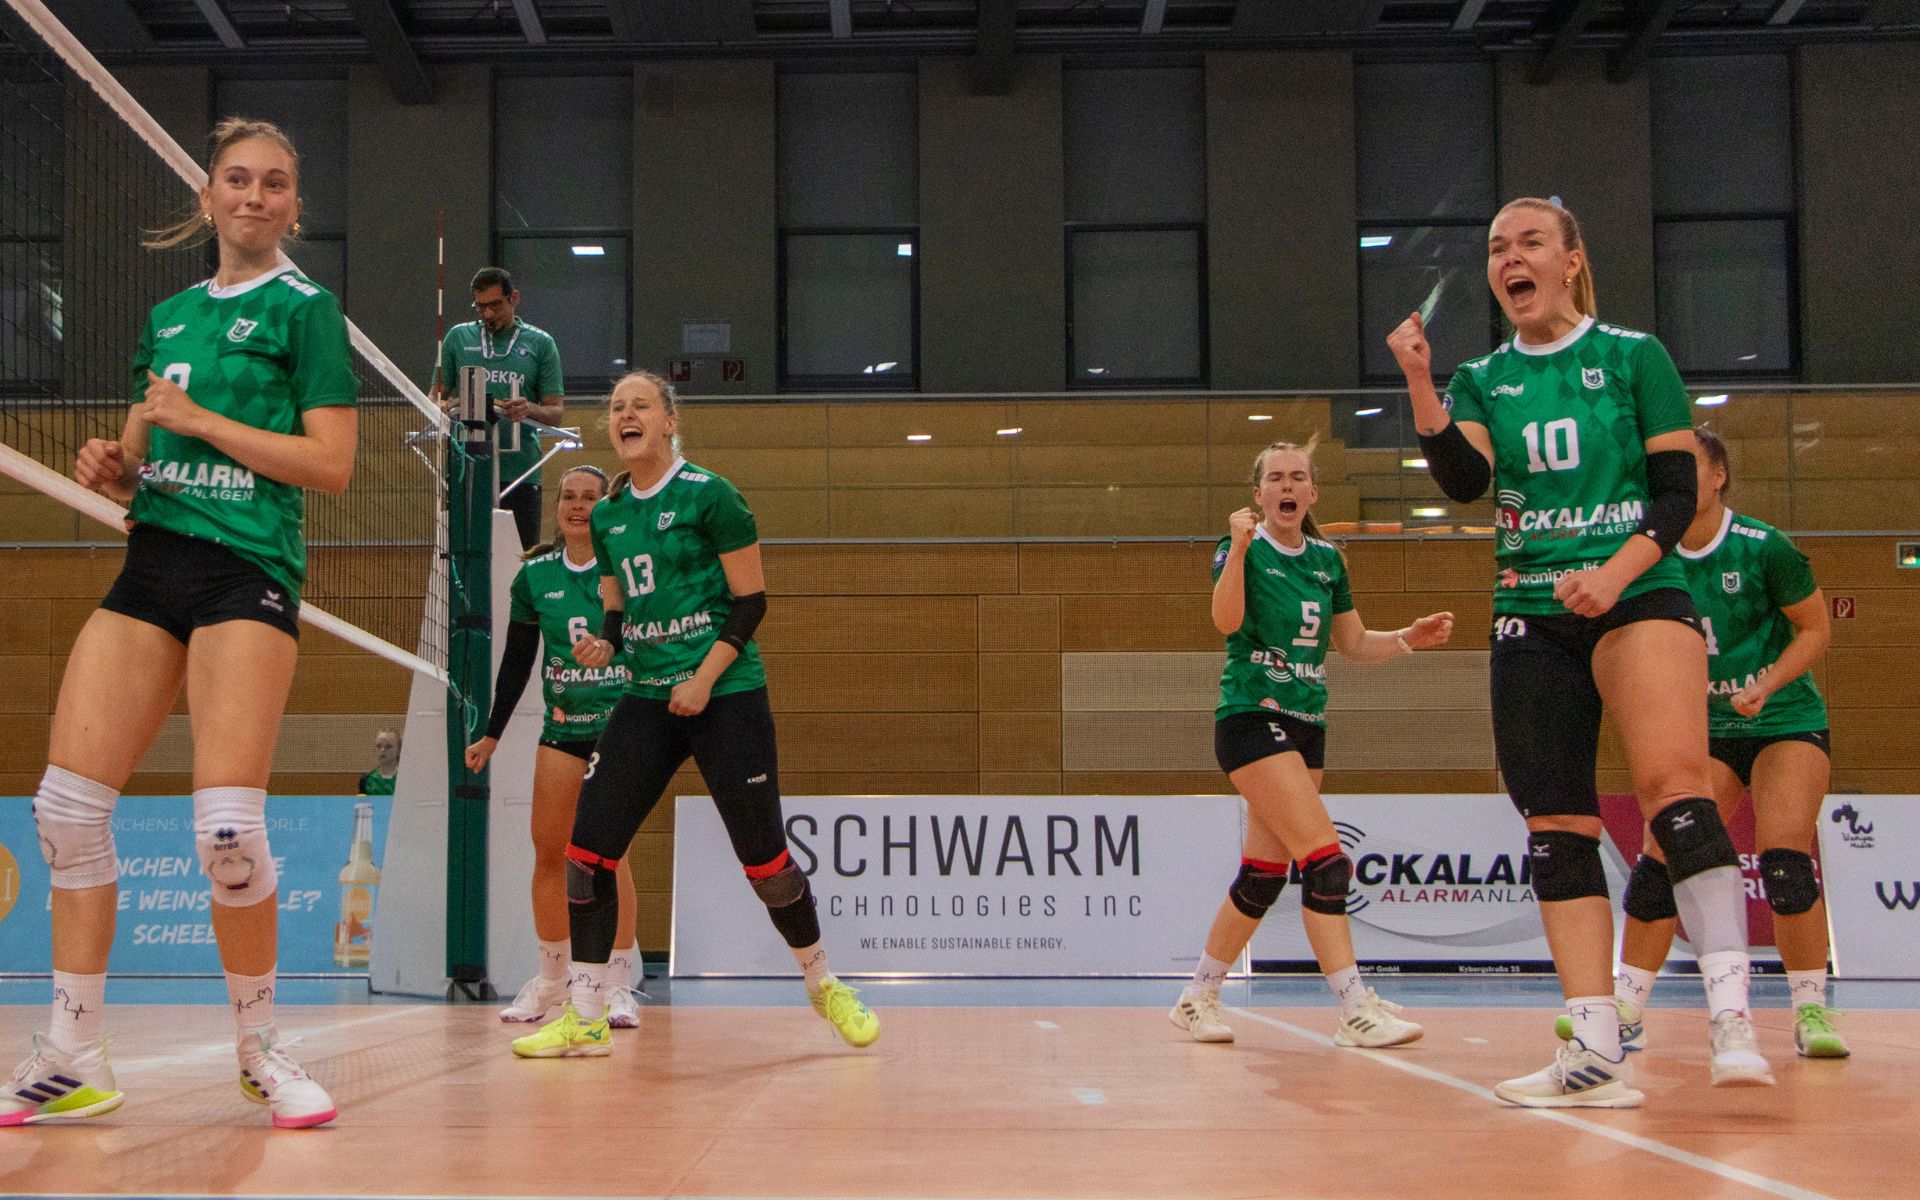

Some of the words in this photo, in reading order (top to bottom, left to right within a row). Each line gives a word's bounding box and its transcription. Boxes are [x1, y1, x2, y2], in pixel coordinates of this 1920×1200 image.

[1522, 417, 1580, 473] 10
[621, 554, 656, 597] 13
[569, 617, 589, 645] 6
[1300, 601, 1320, 637] 5
[1268, 722, 1286, 740] 5
[786, 814, 1140, 877] SCHWARM
[117, 857, 192, 877] NCHEN
[1380, 889, 1536, 902] ALARMANLA
[860, 937, 878, 949] WE
[883, 937, 927, 949] ENABLE
[932, 937, 1012, 950] SUSTAINABLE
[1016, 937, 1067, 950] ENERGY.
